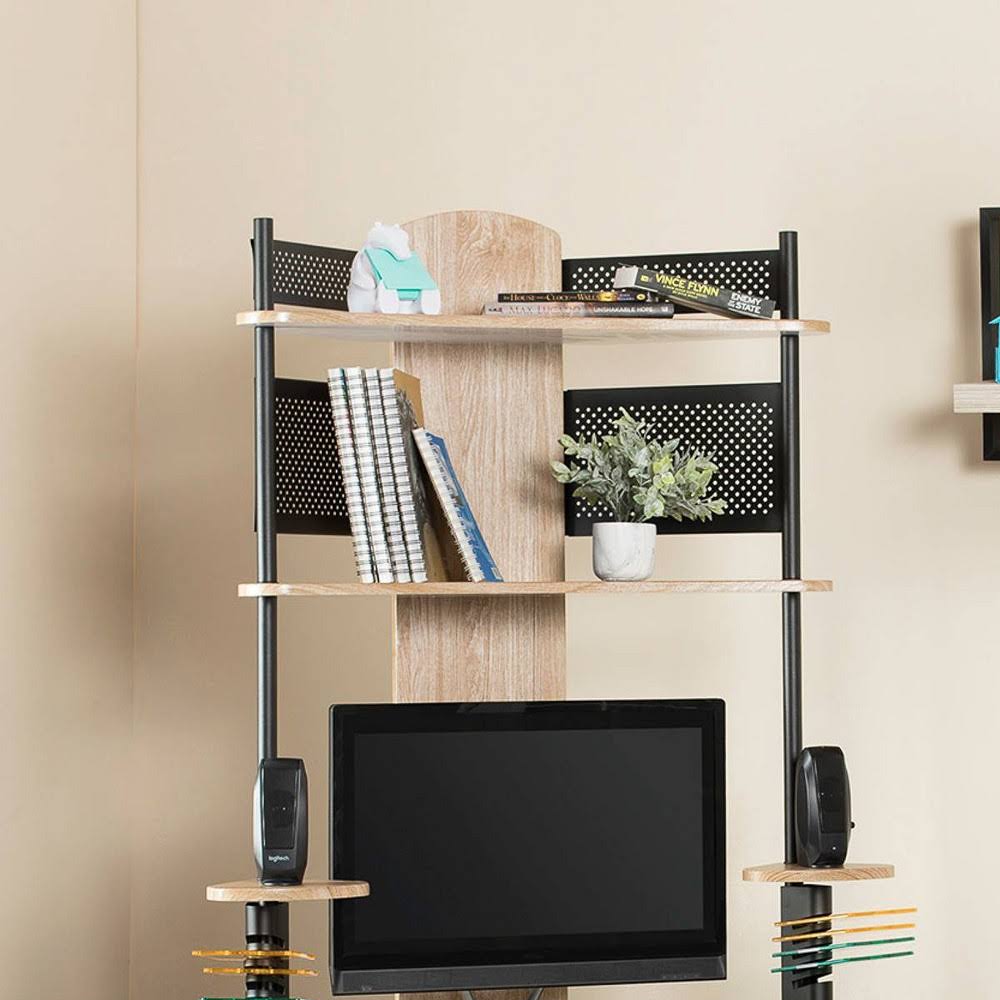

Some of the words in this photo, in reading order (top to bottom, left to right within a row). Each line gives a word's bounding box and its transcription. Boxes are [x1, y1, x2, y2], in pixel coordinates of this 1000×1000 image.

[655, 273, 687, 288] VINCE
[688, 280, 720, 297] FLYNN
[731, 291, 762, 305] ENEMY
[735, 301, 762, 314] STATE
[268, 855, 290, 863] logitech
